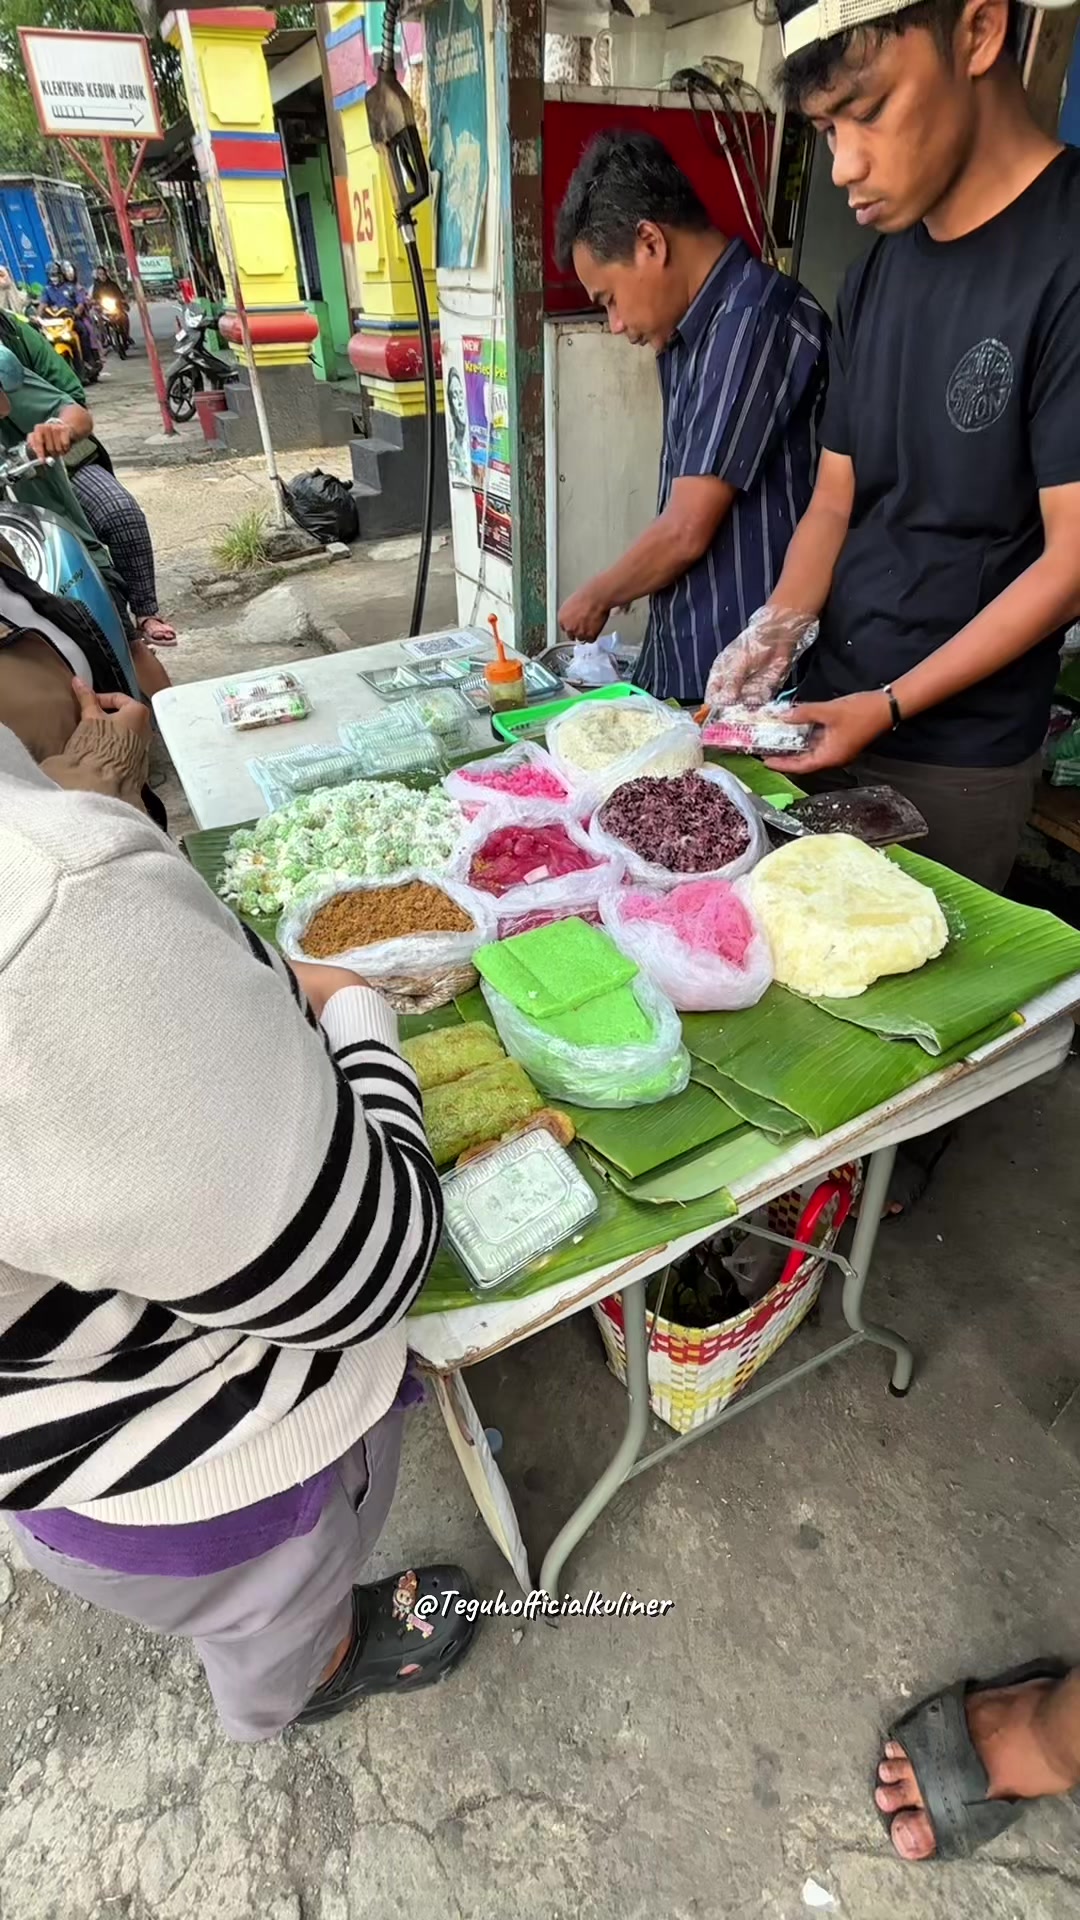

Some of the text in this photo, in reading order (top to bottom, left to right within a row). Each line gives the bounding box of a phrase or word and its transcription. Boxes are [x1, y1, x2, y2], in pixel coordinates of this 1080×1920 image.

[40, 80, 146, 100] KLENTENG KEBUN JERUK
[353, 189, 373, 242] 25
